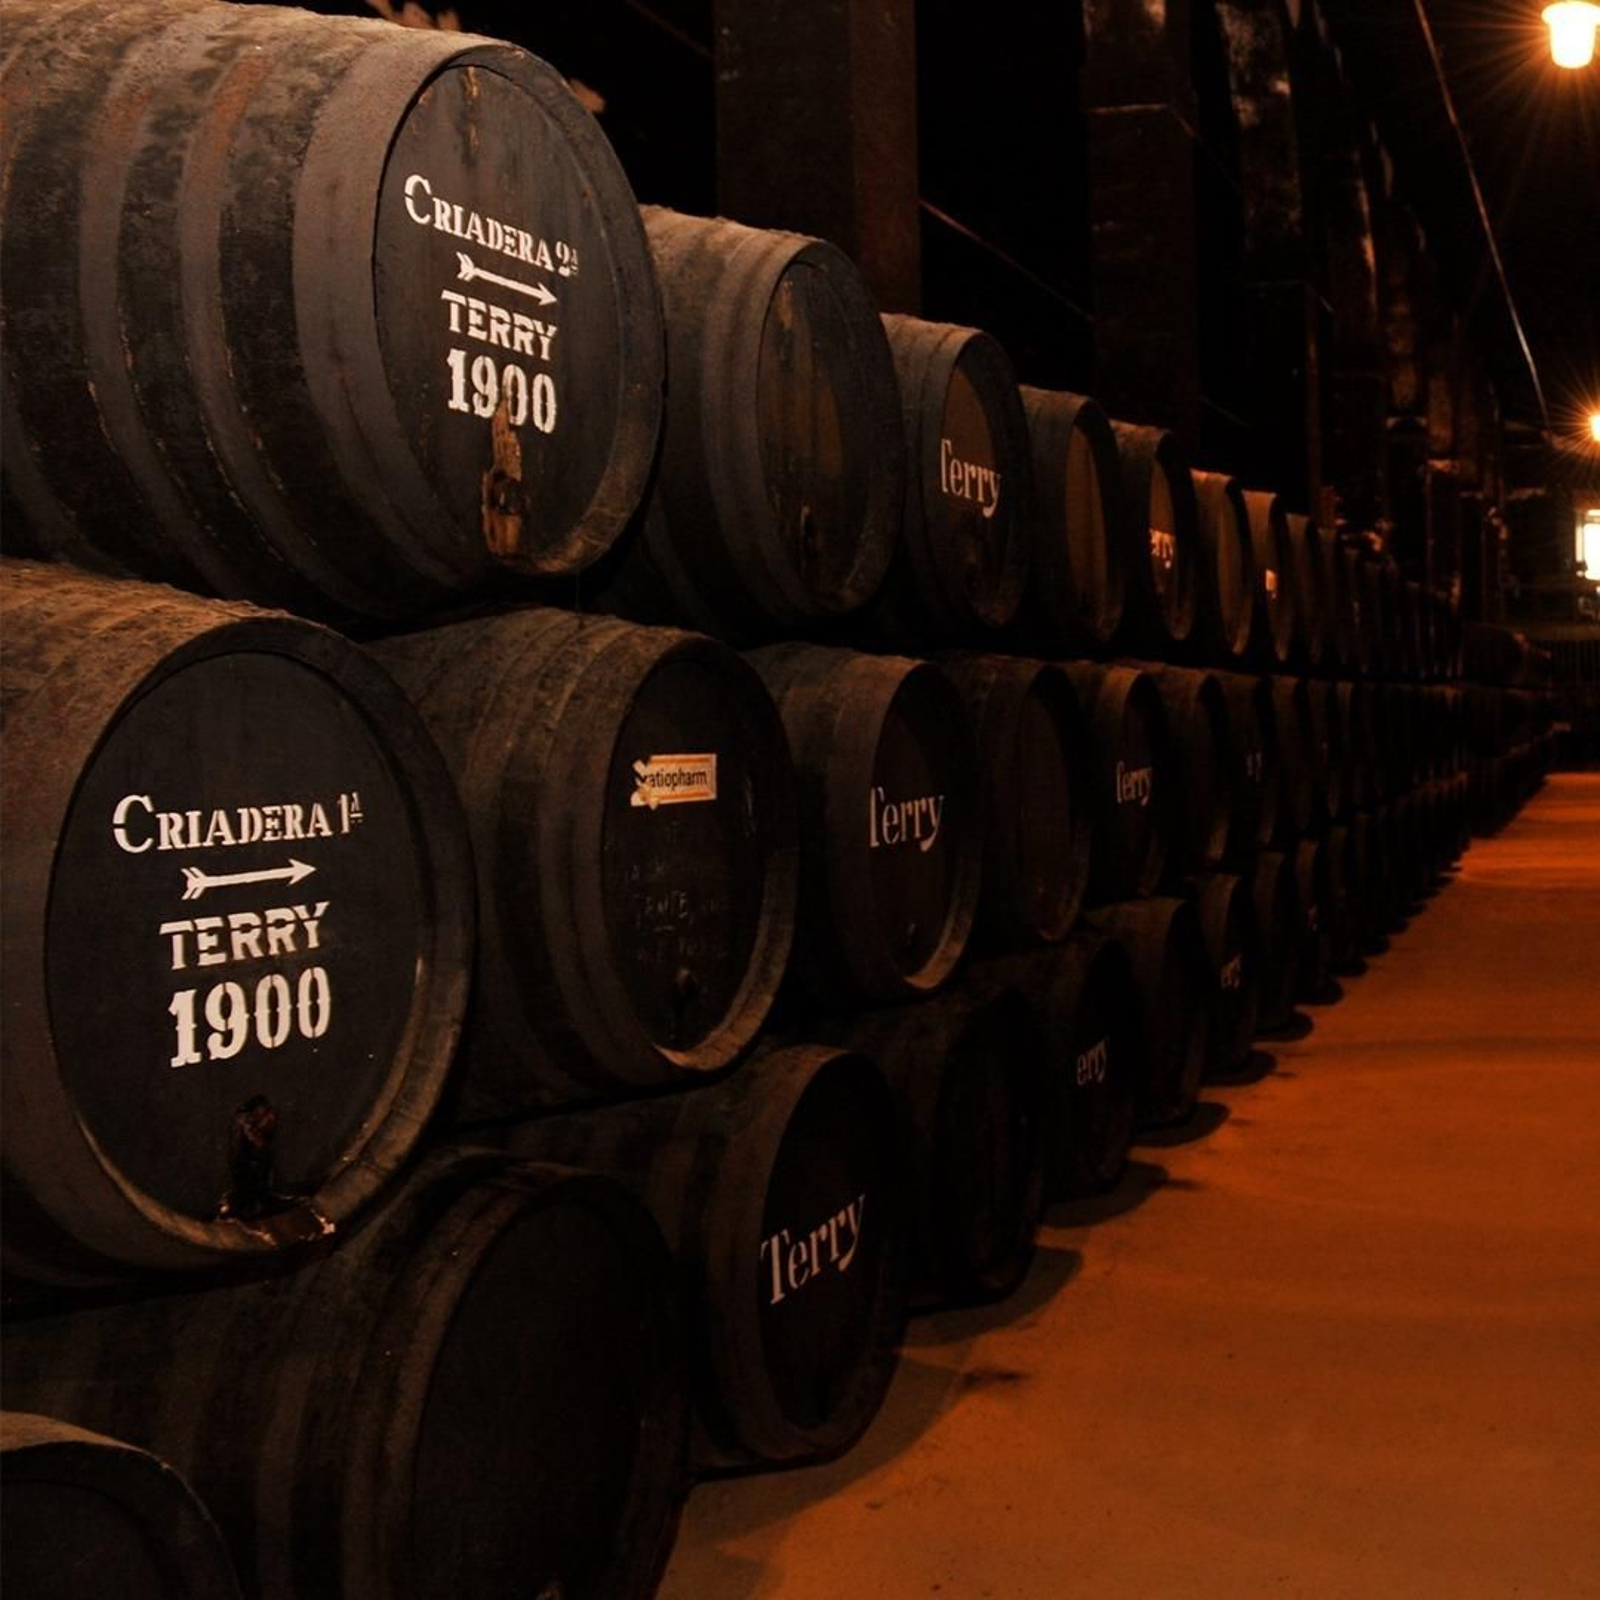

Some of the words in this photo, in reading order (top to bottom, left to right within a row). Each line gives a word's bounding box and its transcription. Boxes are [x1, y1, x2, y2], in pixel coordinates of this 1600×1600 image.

[404, 174, 554, 272] CRIADERA
[441, 289, 557, 361] TERRY
[446, 348, 557, 434] 1900
[645, 766, 707, 791] atiopharm
[112, 794, 333, 854] CRIADERA
[159, 901, 331, 971] TERRY
[167, 966, 332, 1068] 1900
[1076, 1033, 1111, 1087] erry
[759, 1193, 866, 1305] Terry
